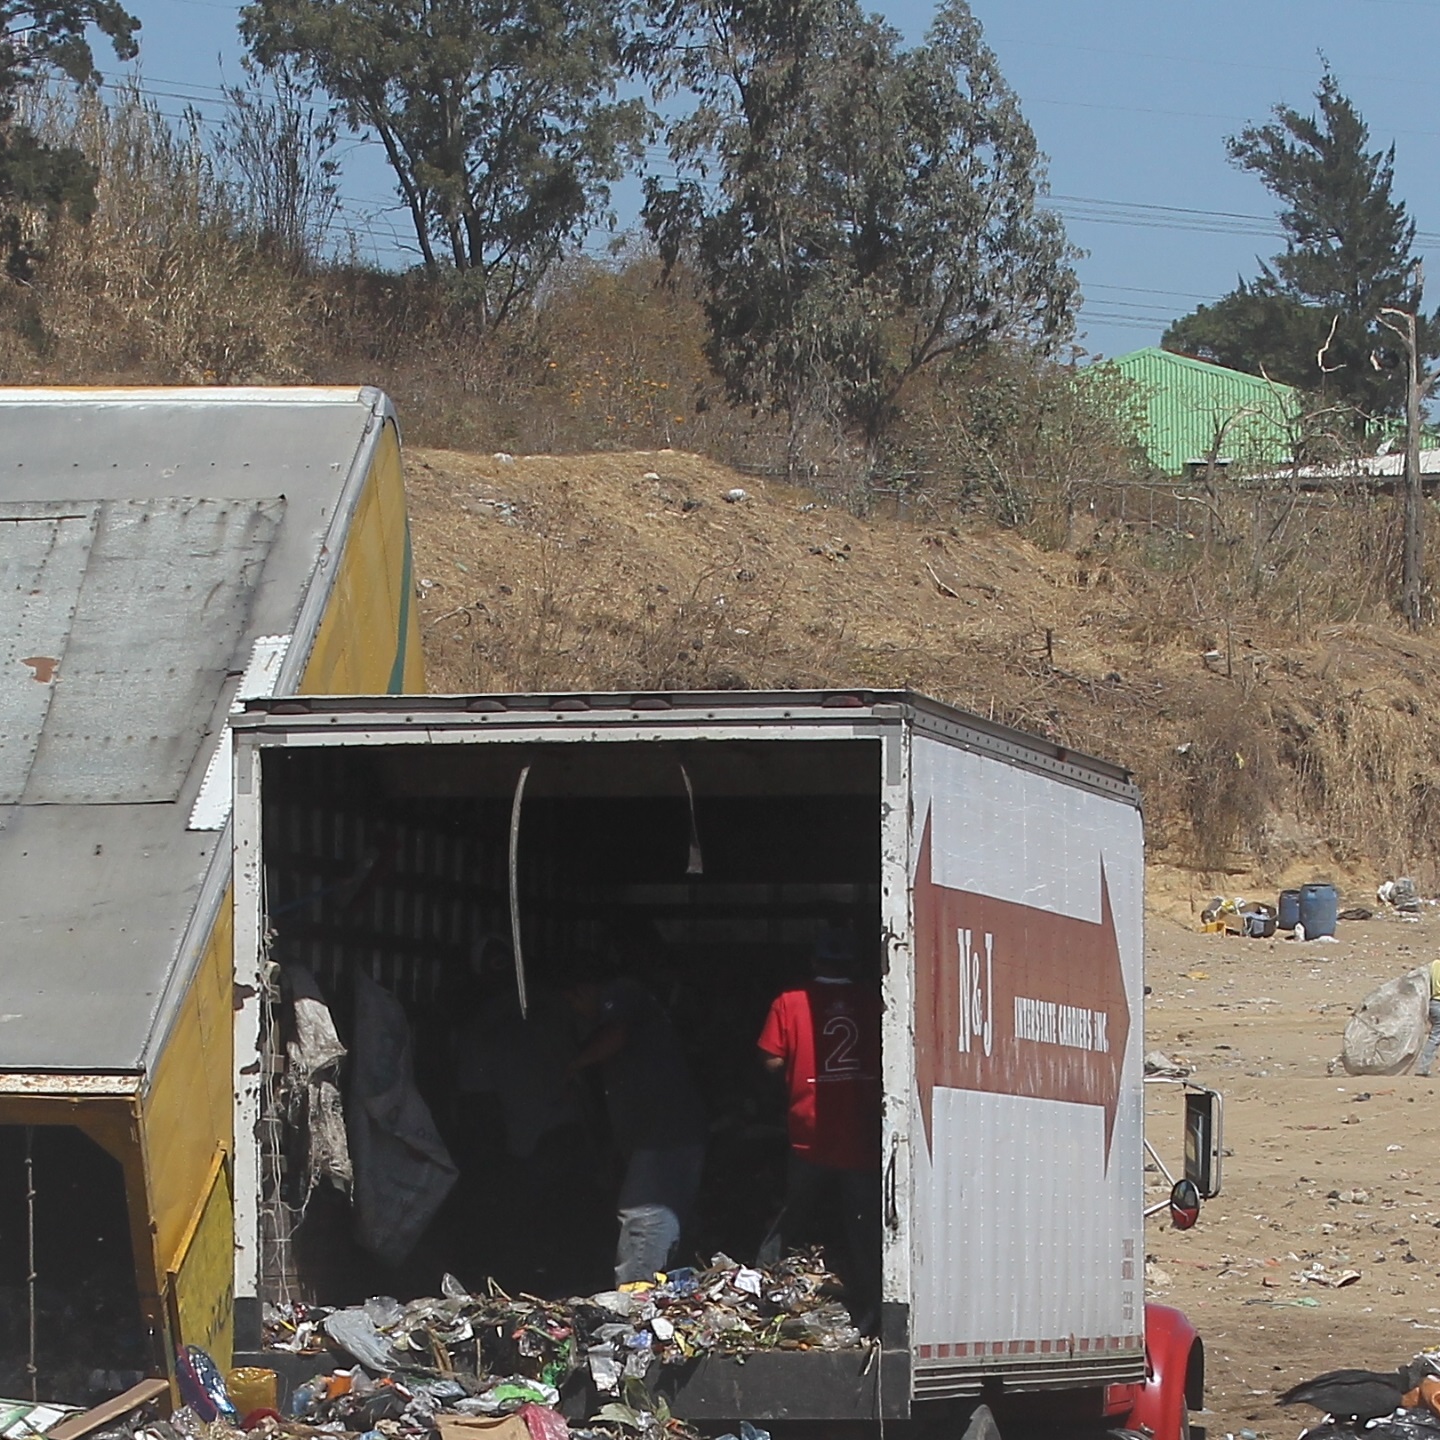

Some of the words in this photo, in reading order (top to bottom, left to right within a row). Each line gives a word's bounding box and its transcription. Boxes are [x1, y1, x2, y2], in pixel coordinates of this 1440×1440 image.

[957, 928, 993, 1057] N&J
[823, 1016, 860, 1072] 2
[1014, 996, 1057, 1044] INTERSTATE
[1058, 1004, 1092, 1051] CARRIERS
